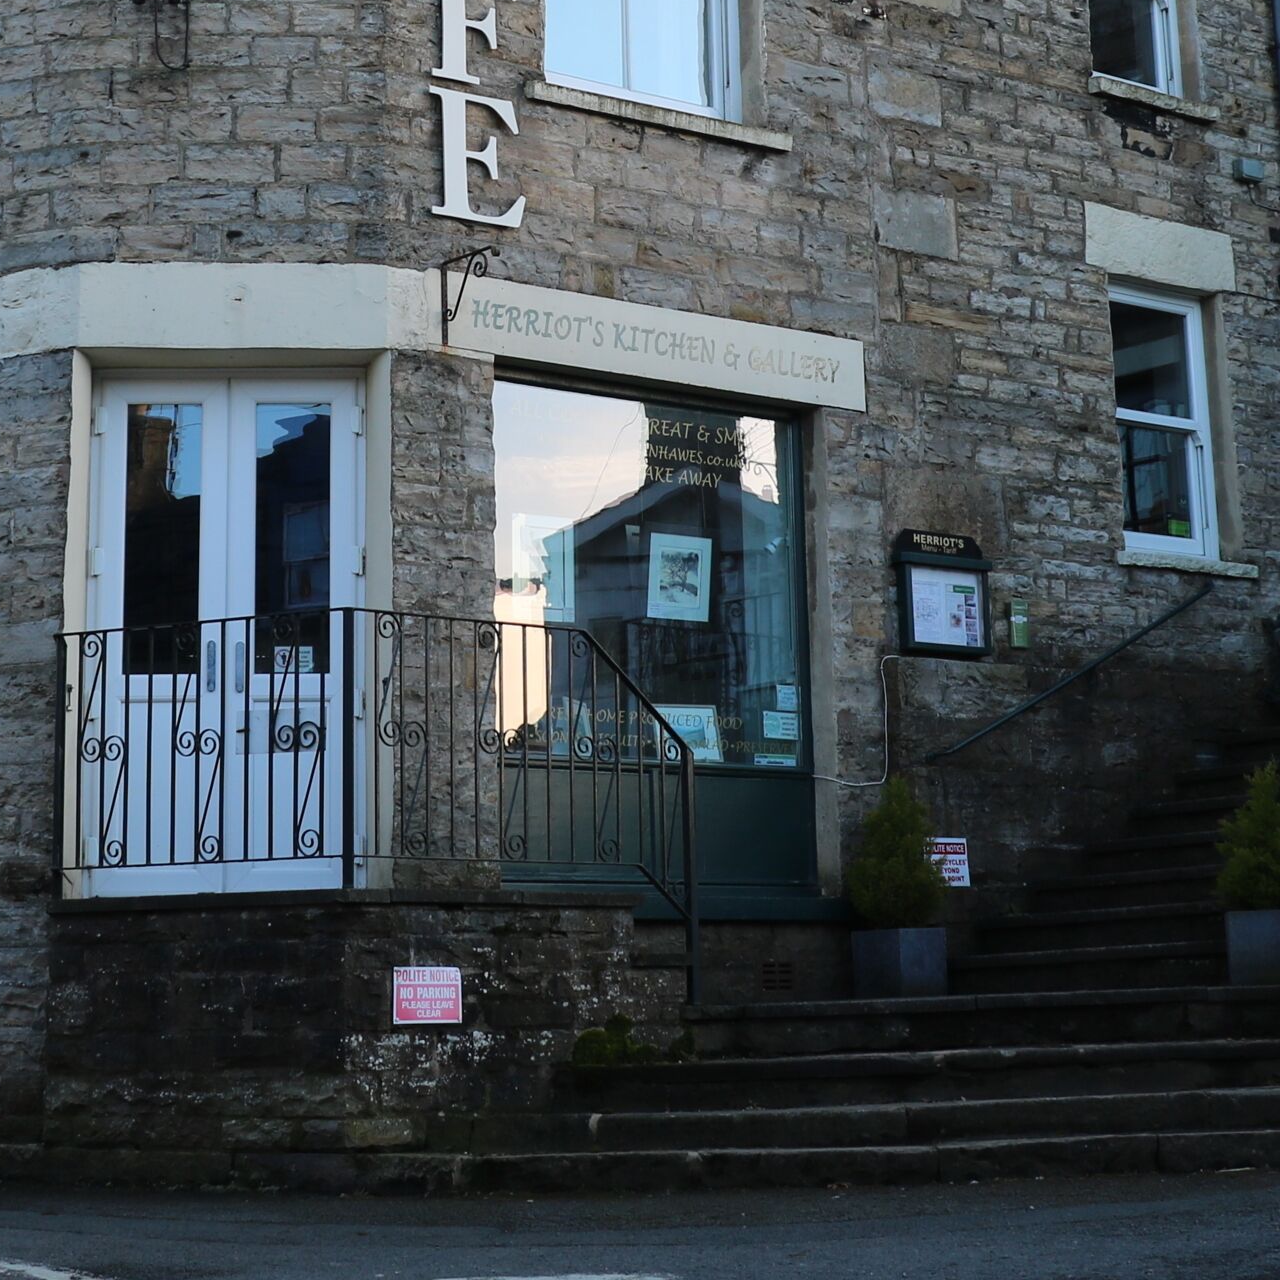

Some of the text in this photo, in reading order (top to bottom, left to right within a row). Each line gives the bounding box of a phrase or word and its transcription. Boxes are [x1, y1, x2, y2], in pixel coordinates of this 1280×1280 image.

[470, 298, 842, 384] HERRIOT'S KITCHEN & GALLERY
[648, 418, 694, 440] REAT
[696, 424, 711, 443] &
[645, 465, 723, 489] AKE AWAY
[912, 532, 965, 549] HERRIOT'S
[706, 716, 744, 730] FOOD
[395, 969, 460, 983] POLITE NOTICE
[400, 986, 456, 999] NO PARKING
[401, 1000, 455, 1009] PLEASE LEAVE
[416, 1009, 442, 1018] CLEAR
